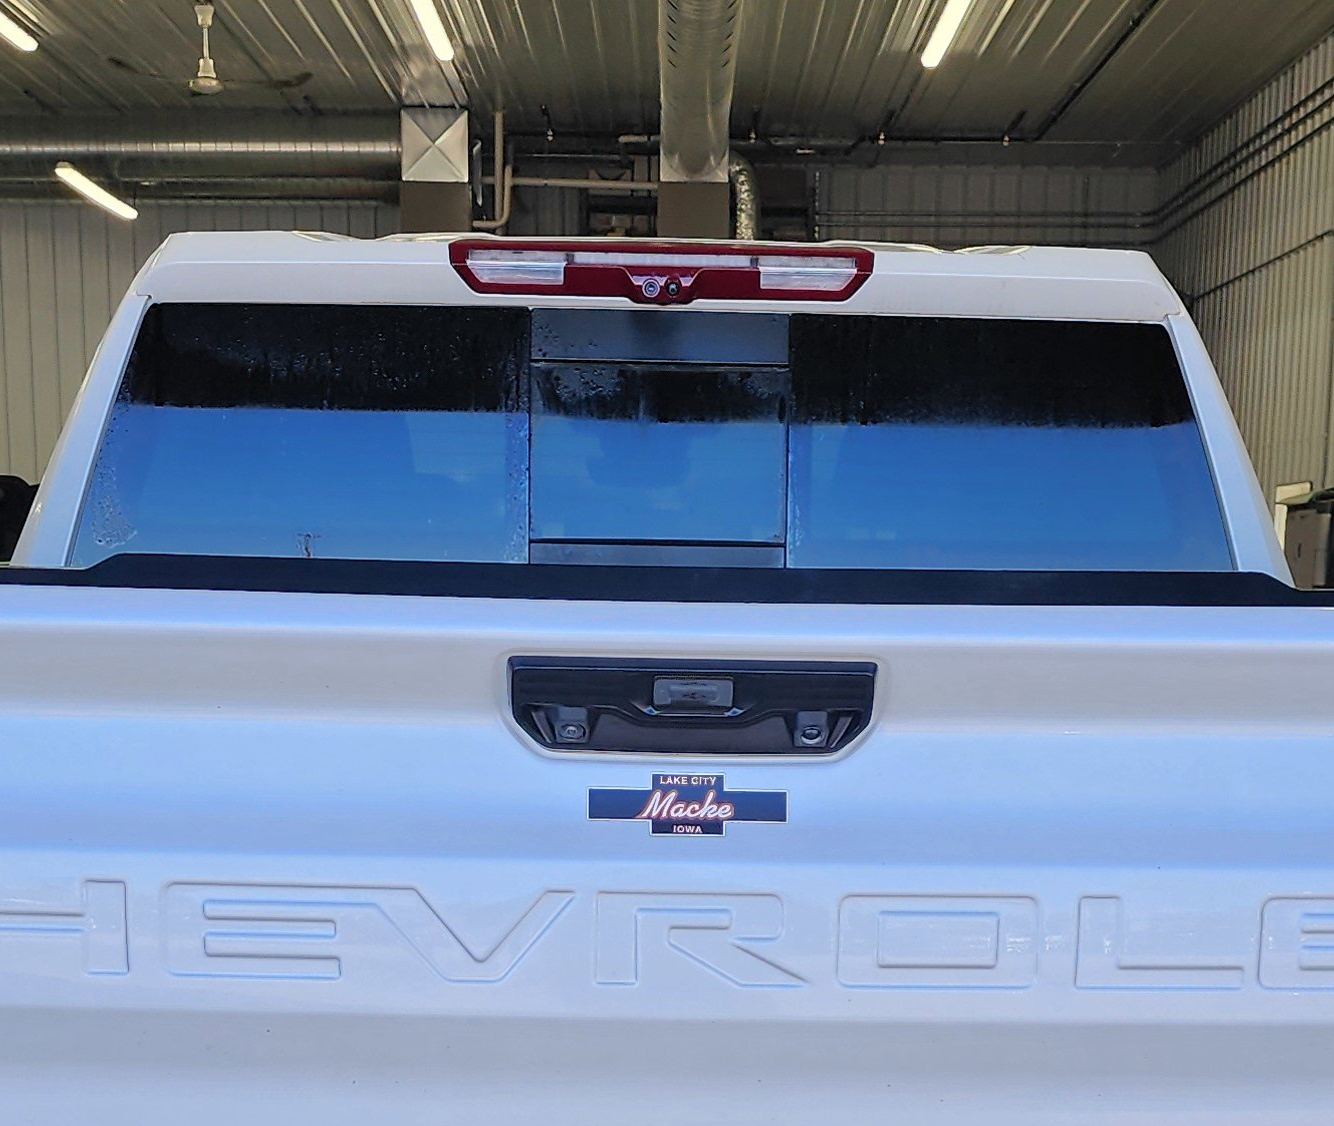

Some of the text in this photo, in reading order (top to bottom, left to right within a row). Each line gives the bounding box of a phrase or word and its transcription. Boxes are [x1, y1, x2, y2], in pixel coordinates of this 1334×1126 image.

[659, 775, 717, 786] LAKE CITY
[634, 788, 735, 821] Macke
[672, 824, 703, 834] IOWA
